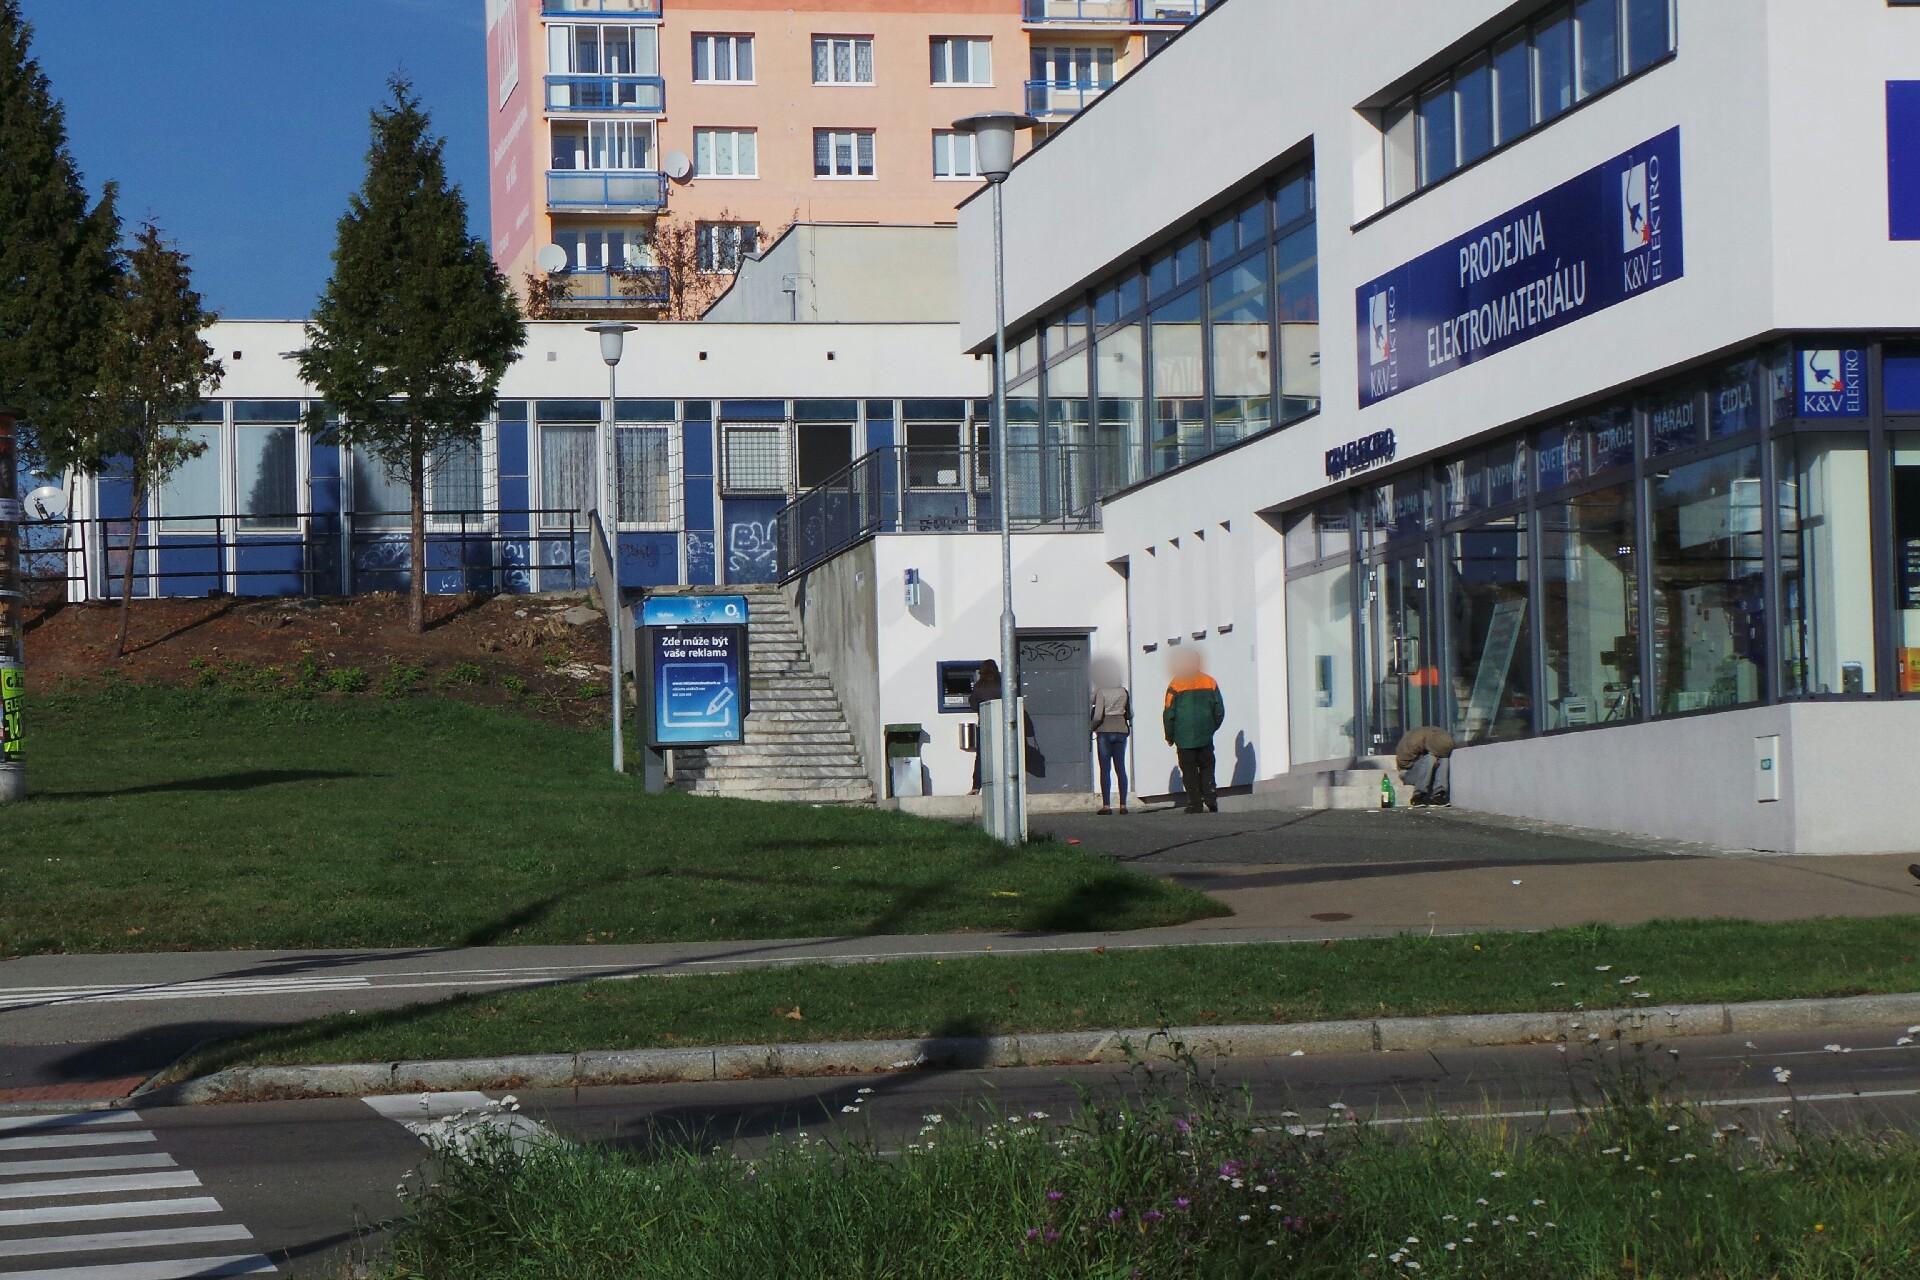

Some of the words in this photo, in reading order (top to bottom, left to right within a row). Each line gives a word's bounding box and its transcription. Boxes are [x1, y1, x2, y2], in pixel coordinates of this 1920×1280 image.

[1649, 155, 1662, 281] ELEKTRO
[1459, 210, 1545, 288] PRODEJNA
[1623, 252, 1652, 292] K&V
[1427, 257, 1586, 368] ELEKTROMATERIÁLU
[1845, 349, 1860, 412] ELEKTRO
[1804, 394, 1844, 413] K&V
[1597, 421, 1633, 454] ZDROJE
[662, 637, 680, 646] Zde
[683, 635, 709, 646] může
[712, 636, 729, 647] být
[664, 649, 686, 658] vaše
[689, 648, 728, 658] reklama
